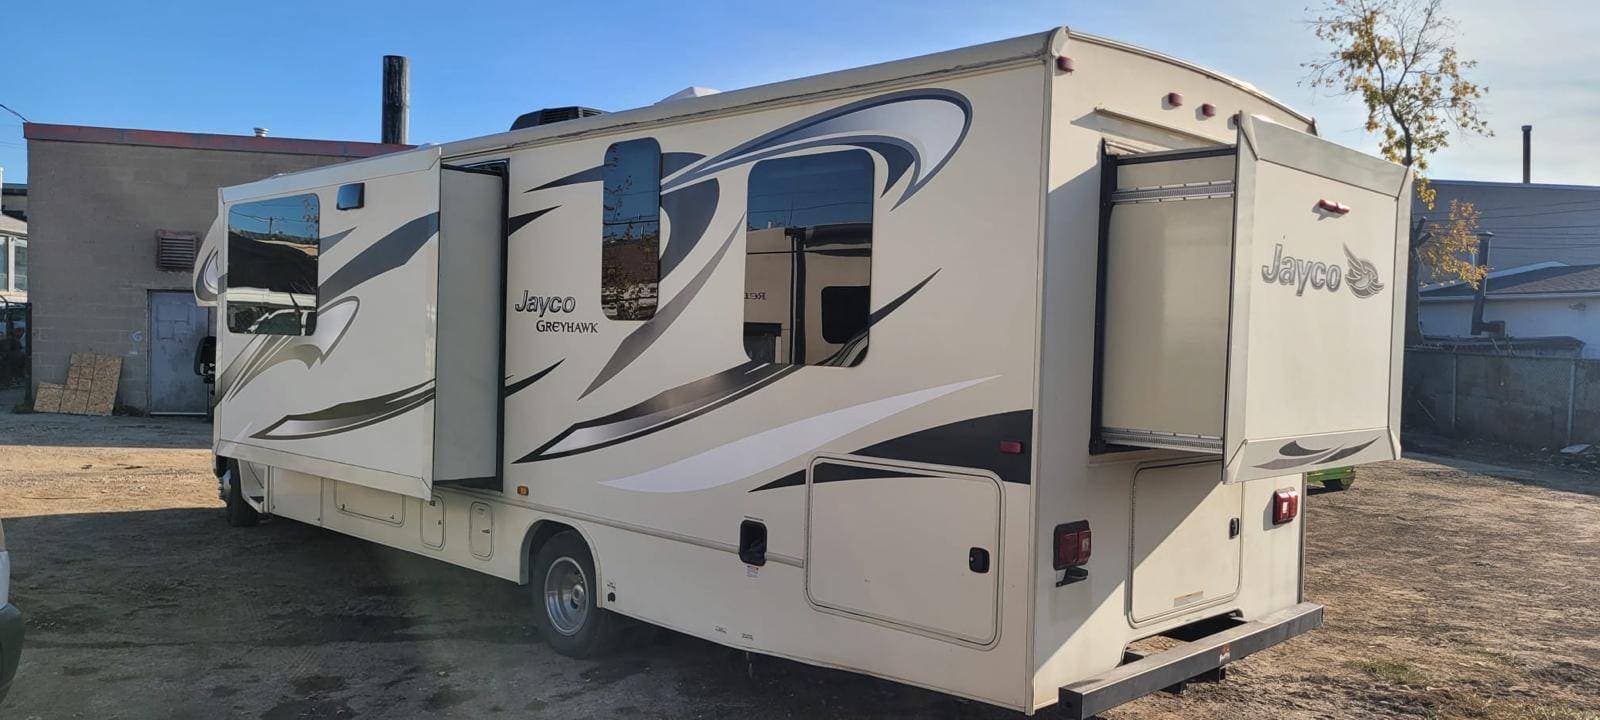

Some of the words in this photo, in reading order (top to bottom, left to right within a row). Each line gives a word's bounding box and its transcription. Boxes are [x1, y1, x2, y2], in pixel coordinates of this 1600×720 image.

[1261, 243, 1342, 297] Jayco
[514, 289, 576, 318] Jayco
[536, 319, 599, 334] GREYHAWK
